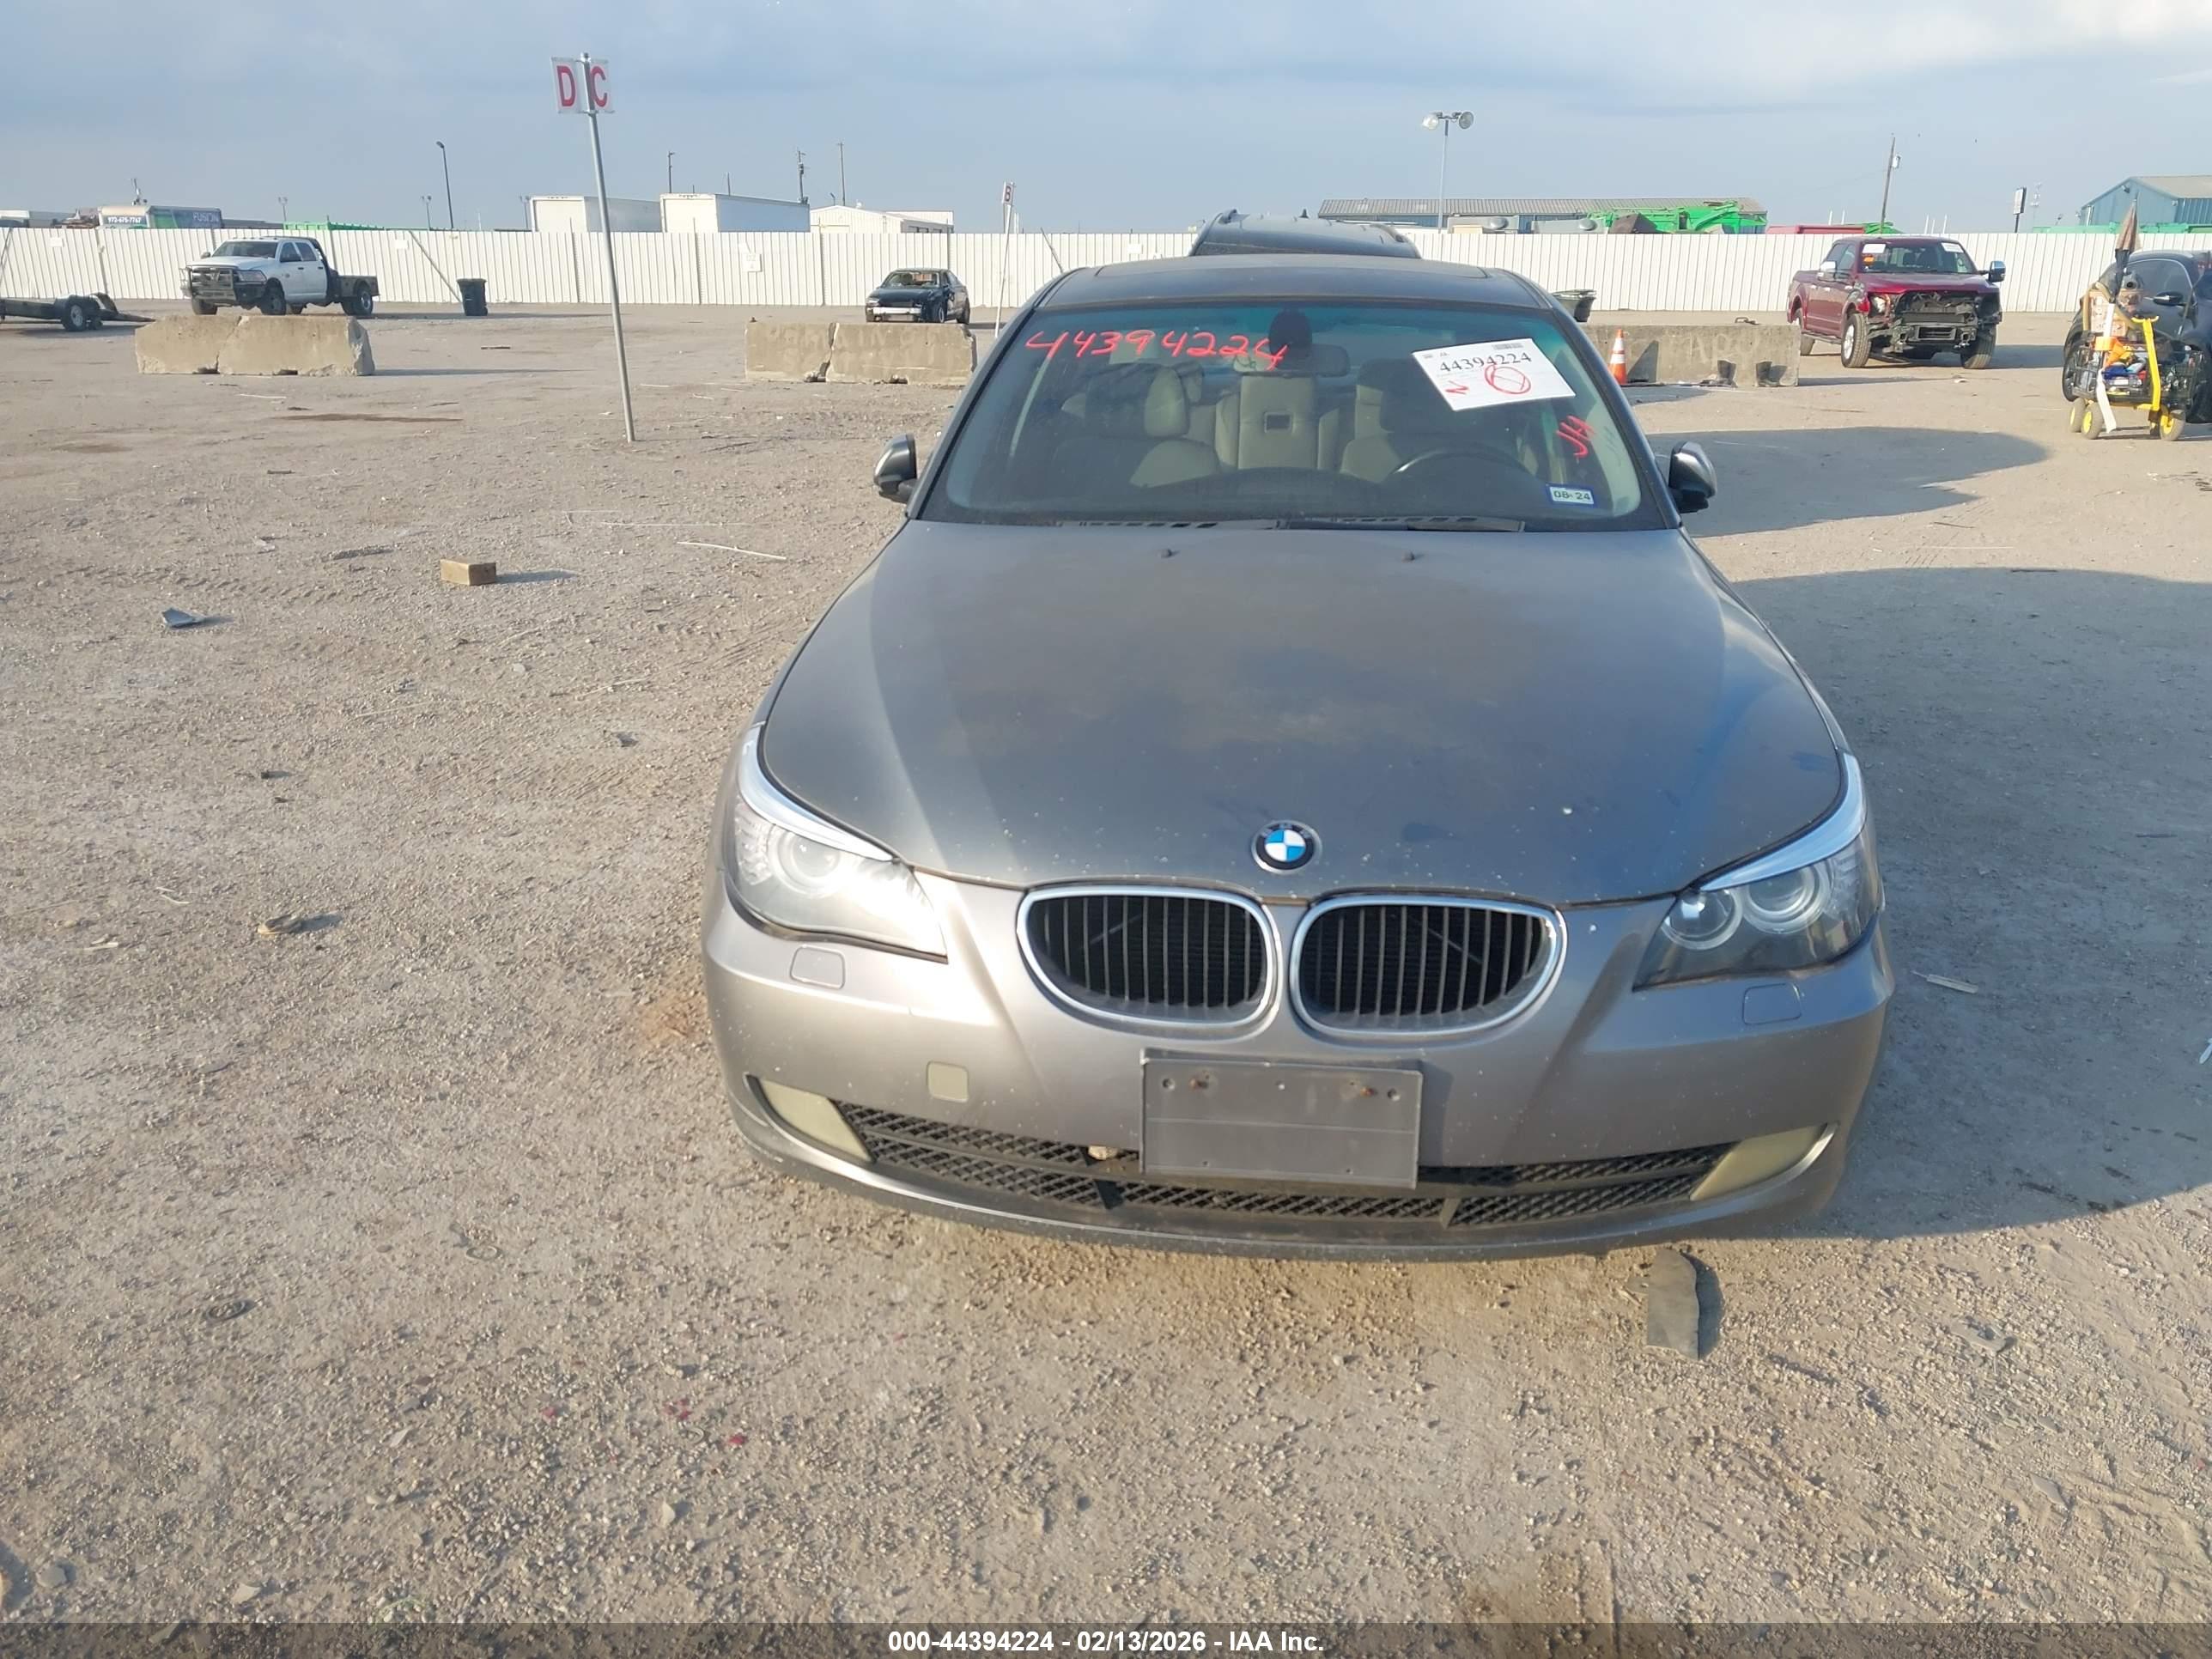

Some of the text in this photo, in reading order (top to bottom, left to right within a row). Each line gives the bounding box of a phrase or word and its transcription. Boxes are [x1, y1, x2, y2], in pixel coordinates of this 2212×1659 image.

[556, 65, 607, 107] D C
[1004, 185, 1012, 202] B
[1025, 330, 1287, 371] 44394224
[1440, 352, 1532, 372] 44394224
